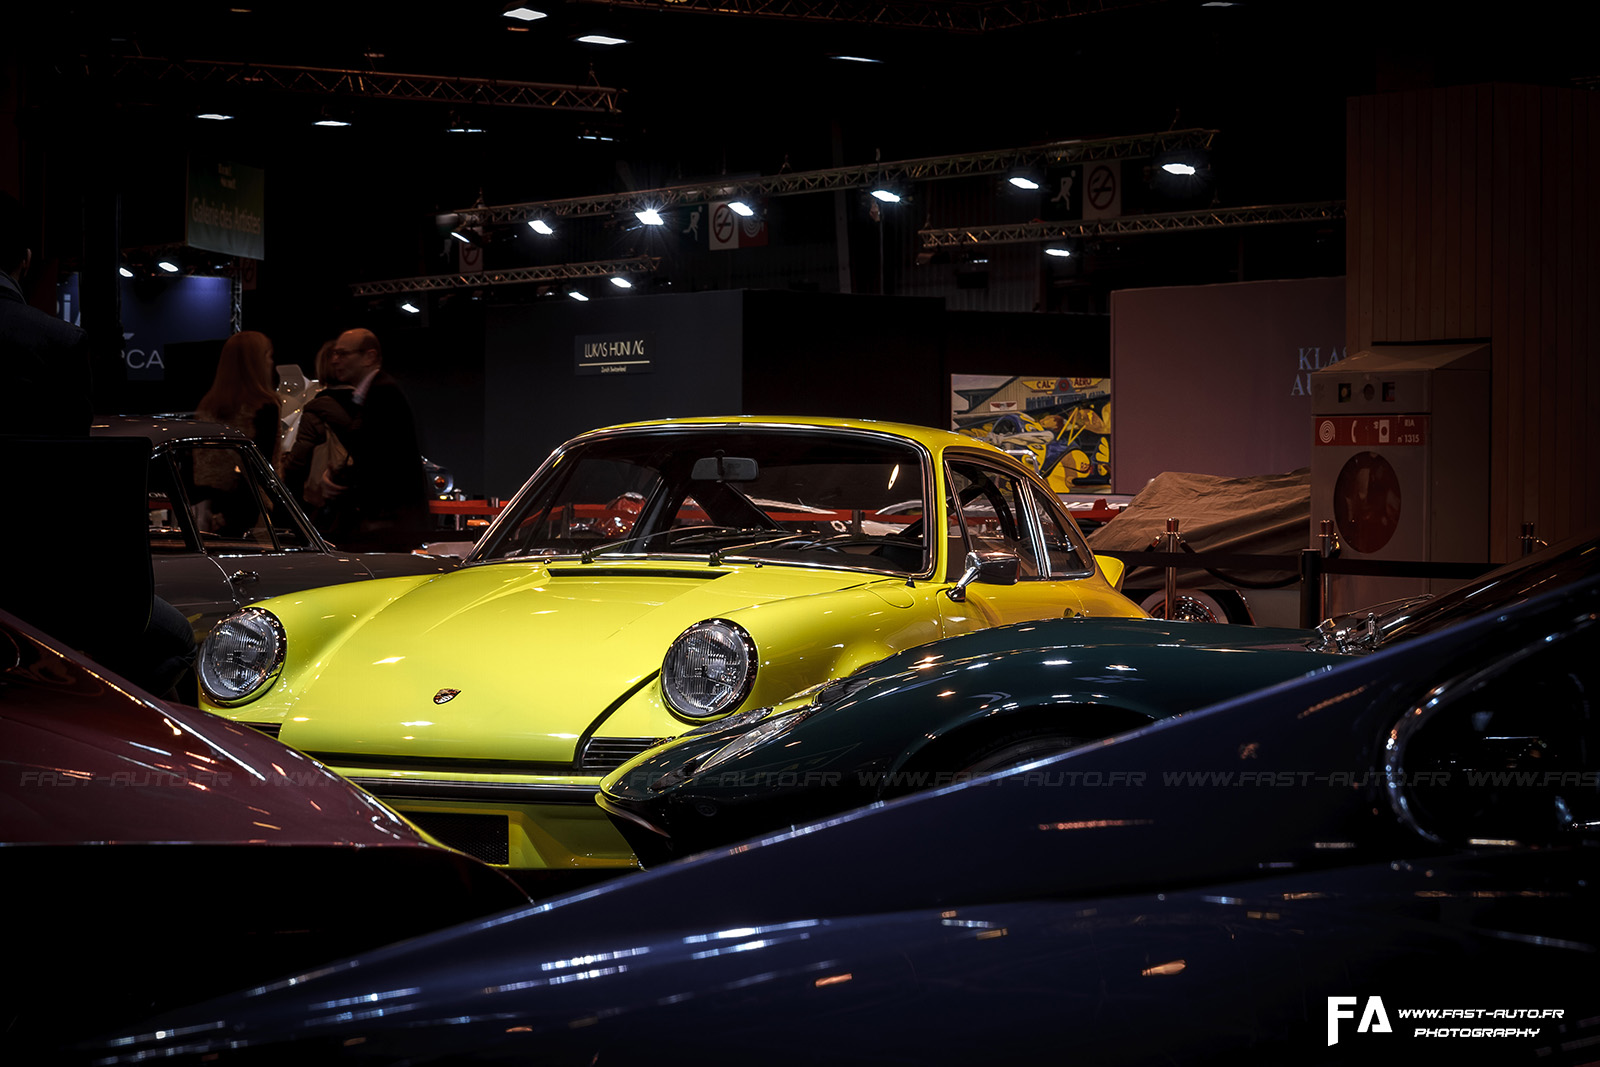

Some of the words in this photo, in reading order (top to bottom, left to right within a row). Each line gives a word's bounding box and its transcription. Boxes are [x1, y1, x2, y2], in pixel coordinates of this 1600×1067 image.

[192, 197, 219, 226] Galerie
[584, 342, 608, 358] LUKAS
[632, 339, 645, 355] AG
[121, 349, 165, 370] CA
